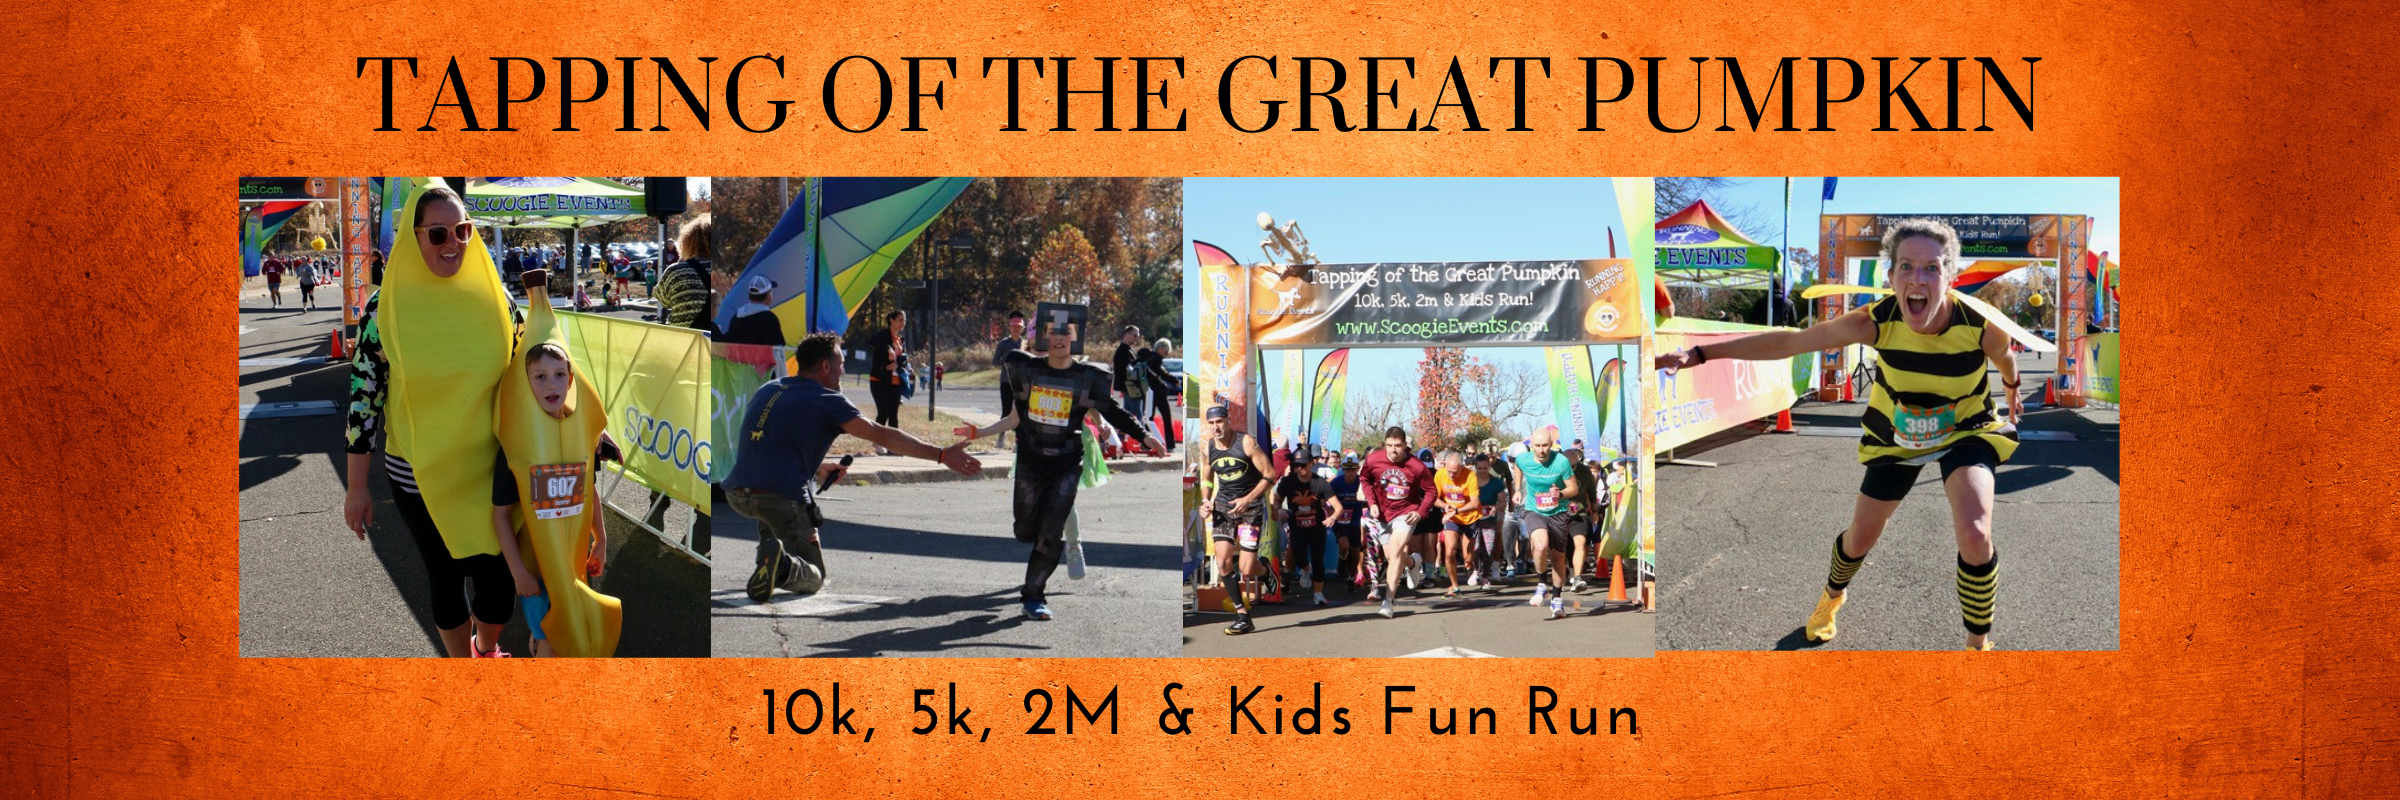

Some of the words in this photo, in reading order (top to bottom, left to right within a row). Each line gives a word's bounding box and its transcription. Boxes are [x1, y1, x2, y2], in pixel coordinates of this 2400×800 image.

[464, 193, 550, 212] SCOOGIE
[556, 193, 632, 211] EVENTS
[1982, 215, 2026, 228] Pumpkin
[1667, 247, 1747, 266] EVENTS
[1308, 267, 1379, 290] Tapping
[1384, 266, 1406, 283] of
[1410, 264, 1439, 283] the
[1445, 263, 1498, 283] Great
[1501, 263, 1581, 286] Pumpkin
[1585, 262, 1624, 289] RUNNING
[1354, 293, 1385, 308] 10k,
[1415, 294, 1438, 307] 2m
[1444, 292, 1455, 306] &
[1459, 292, 1494, 307] Kids
[1498, 292, 1534, 307] Run!
[1336, 315, 1550, 338] www.ScoogieEvents.com
[1904, 416, 1939, 434] 398
[547, 475, 578, 499] 607
